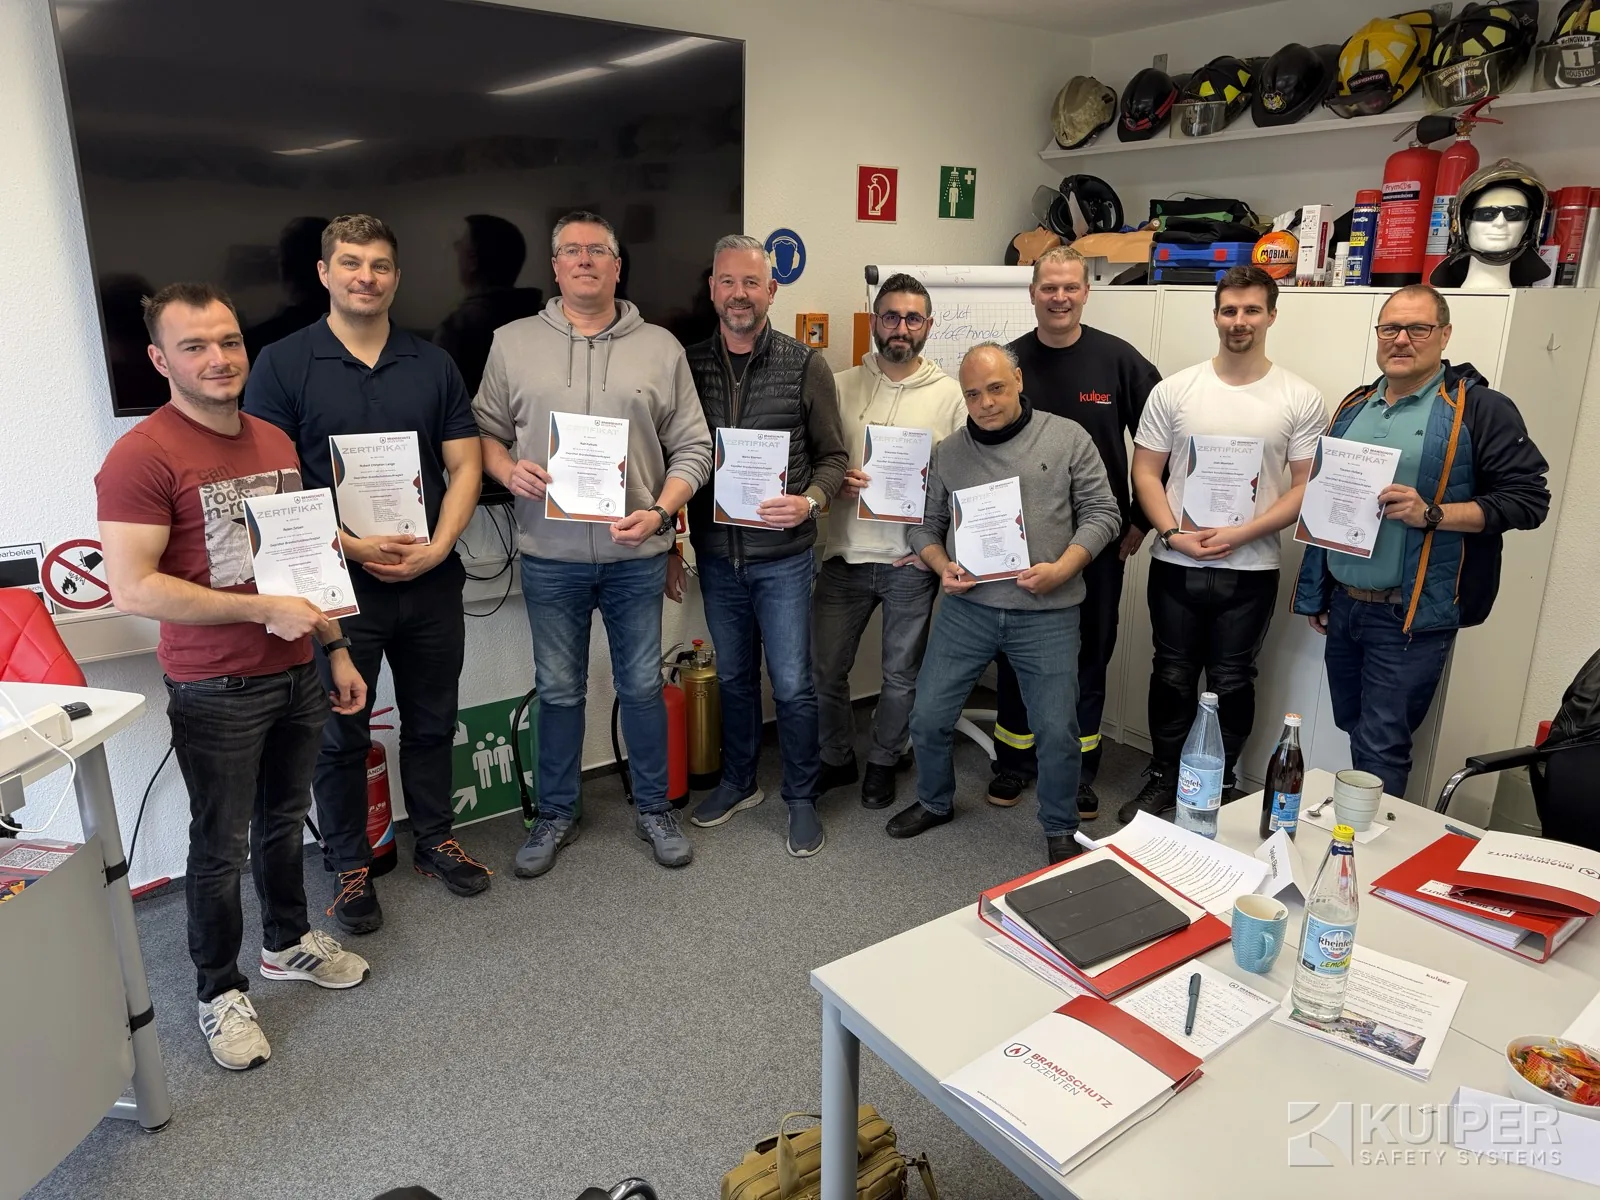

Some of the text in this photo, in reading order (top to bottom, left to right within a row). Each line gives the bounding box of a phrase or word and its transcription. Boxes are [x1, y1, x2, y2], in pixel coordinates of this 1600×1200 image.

[1573, 51, 1581, 67] 1
[1565, 68, 1596, 78] HOUSTON
[342, 444, 407, 454] ZERTIFIKAT
[1197, 445, 1255, 454] ZERTIFIKAT
[1324, 448, 1388, 465] ZERTIFIKAT
[257, 503, 323, 519] ZERTIFIKAT
[1023, 1057, 1081, 1096] DOZENTEN
[1030, 1052, 1113, 1109] BRANDSCHUTZ
